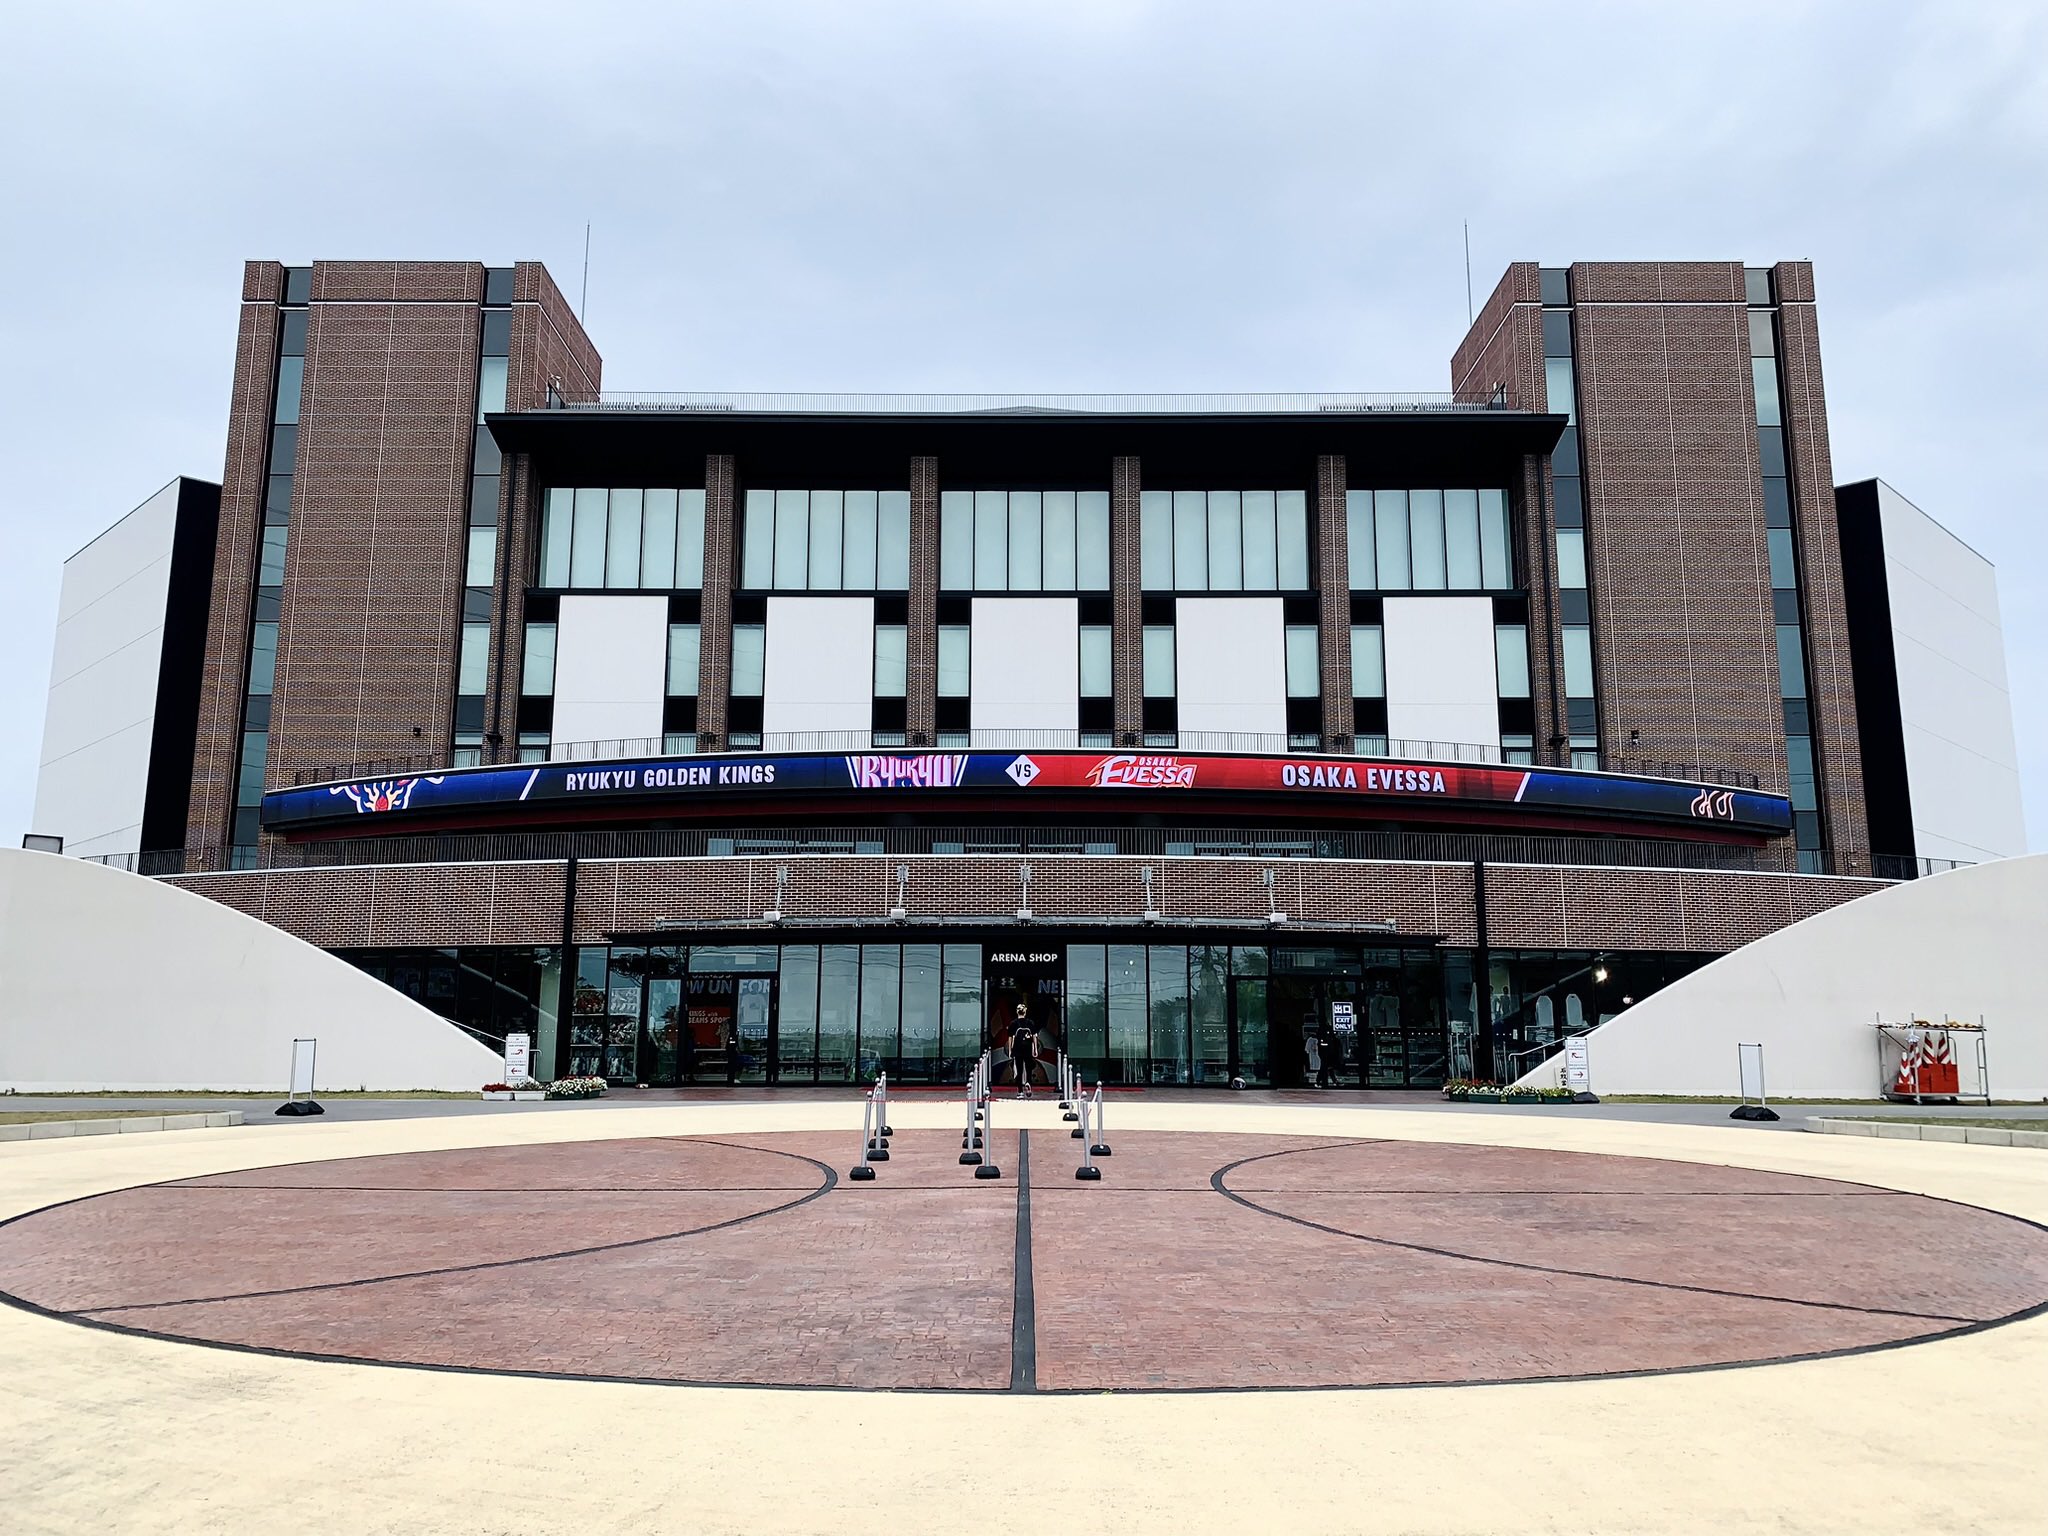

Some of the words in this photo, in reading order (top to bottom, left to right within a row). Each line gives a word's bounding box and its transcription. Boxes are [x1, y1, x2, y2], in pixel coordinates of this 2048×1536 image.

[1139, 757, 1172, 767] OSAKA
[1015, 764, 1032, 778] VS
[566, 770, 636, 791] RYUKYU
[643, 767, 711, 788] GOLDEN
[718, 764, 775, 784] KINGS
[1282, 764, 1357, 788] OSAKA
[1367, 768, 1446, 792] EVESSA
[991, 953, 1026, 962] ARENA
[1029, 953, 1058, 962] SHOP
[1334, 1004, 1351, 1014] 出口
